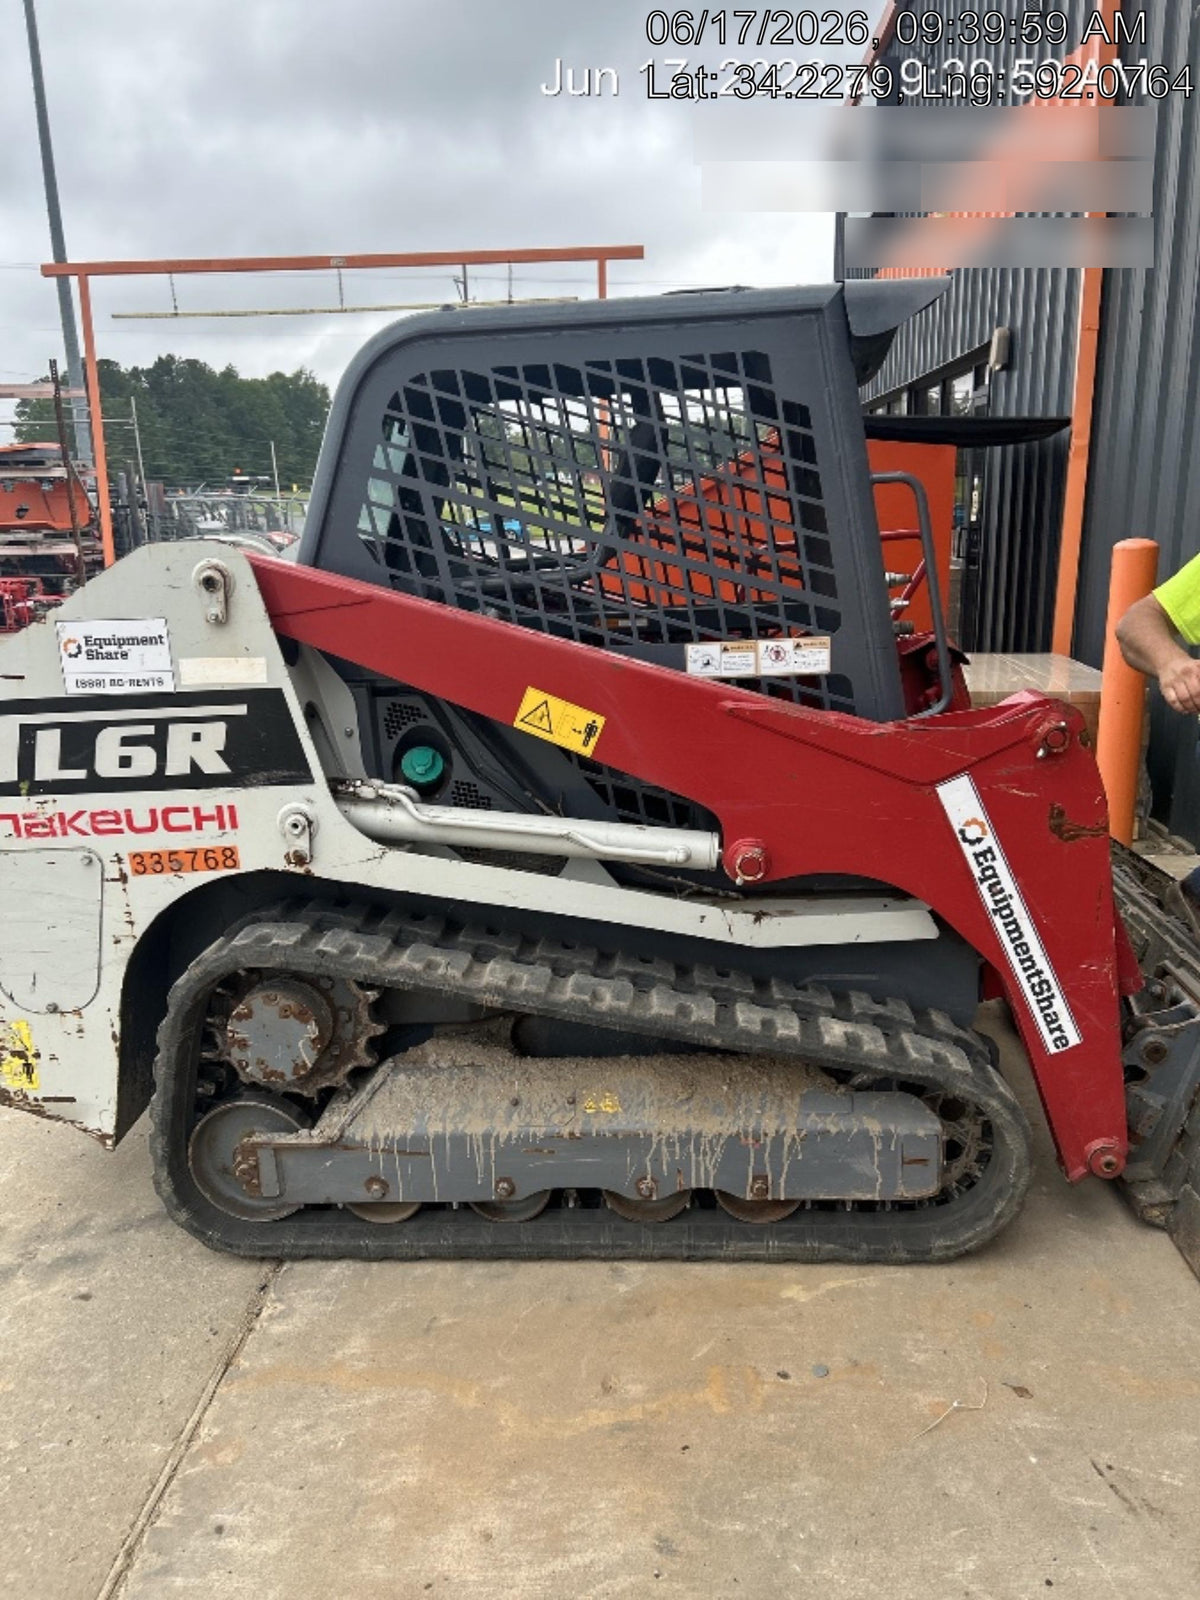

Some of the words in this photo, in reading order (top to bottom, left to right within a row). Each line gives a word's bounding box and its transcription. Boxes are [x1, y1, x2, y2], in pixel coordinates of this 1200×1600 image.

[83, 634, 165, 650] Equipment
[85, 648, 129, 661] Share
[131, 848, 238, 876] 335768
[972, 846, 1070, 1050] EquipmentShare
